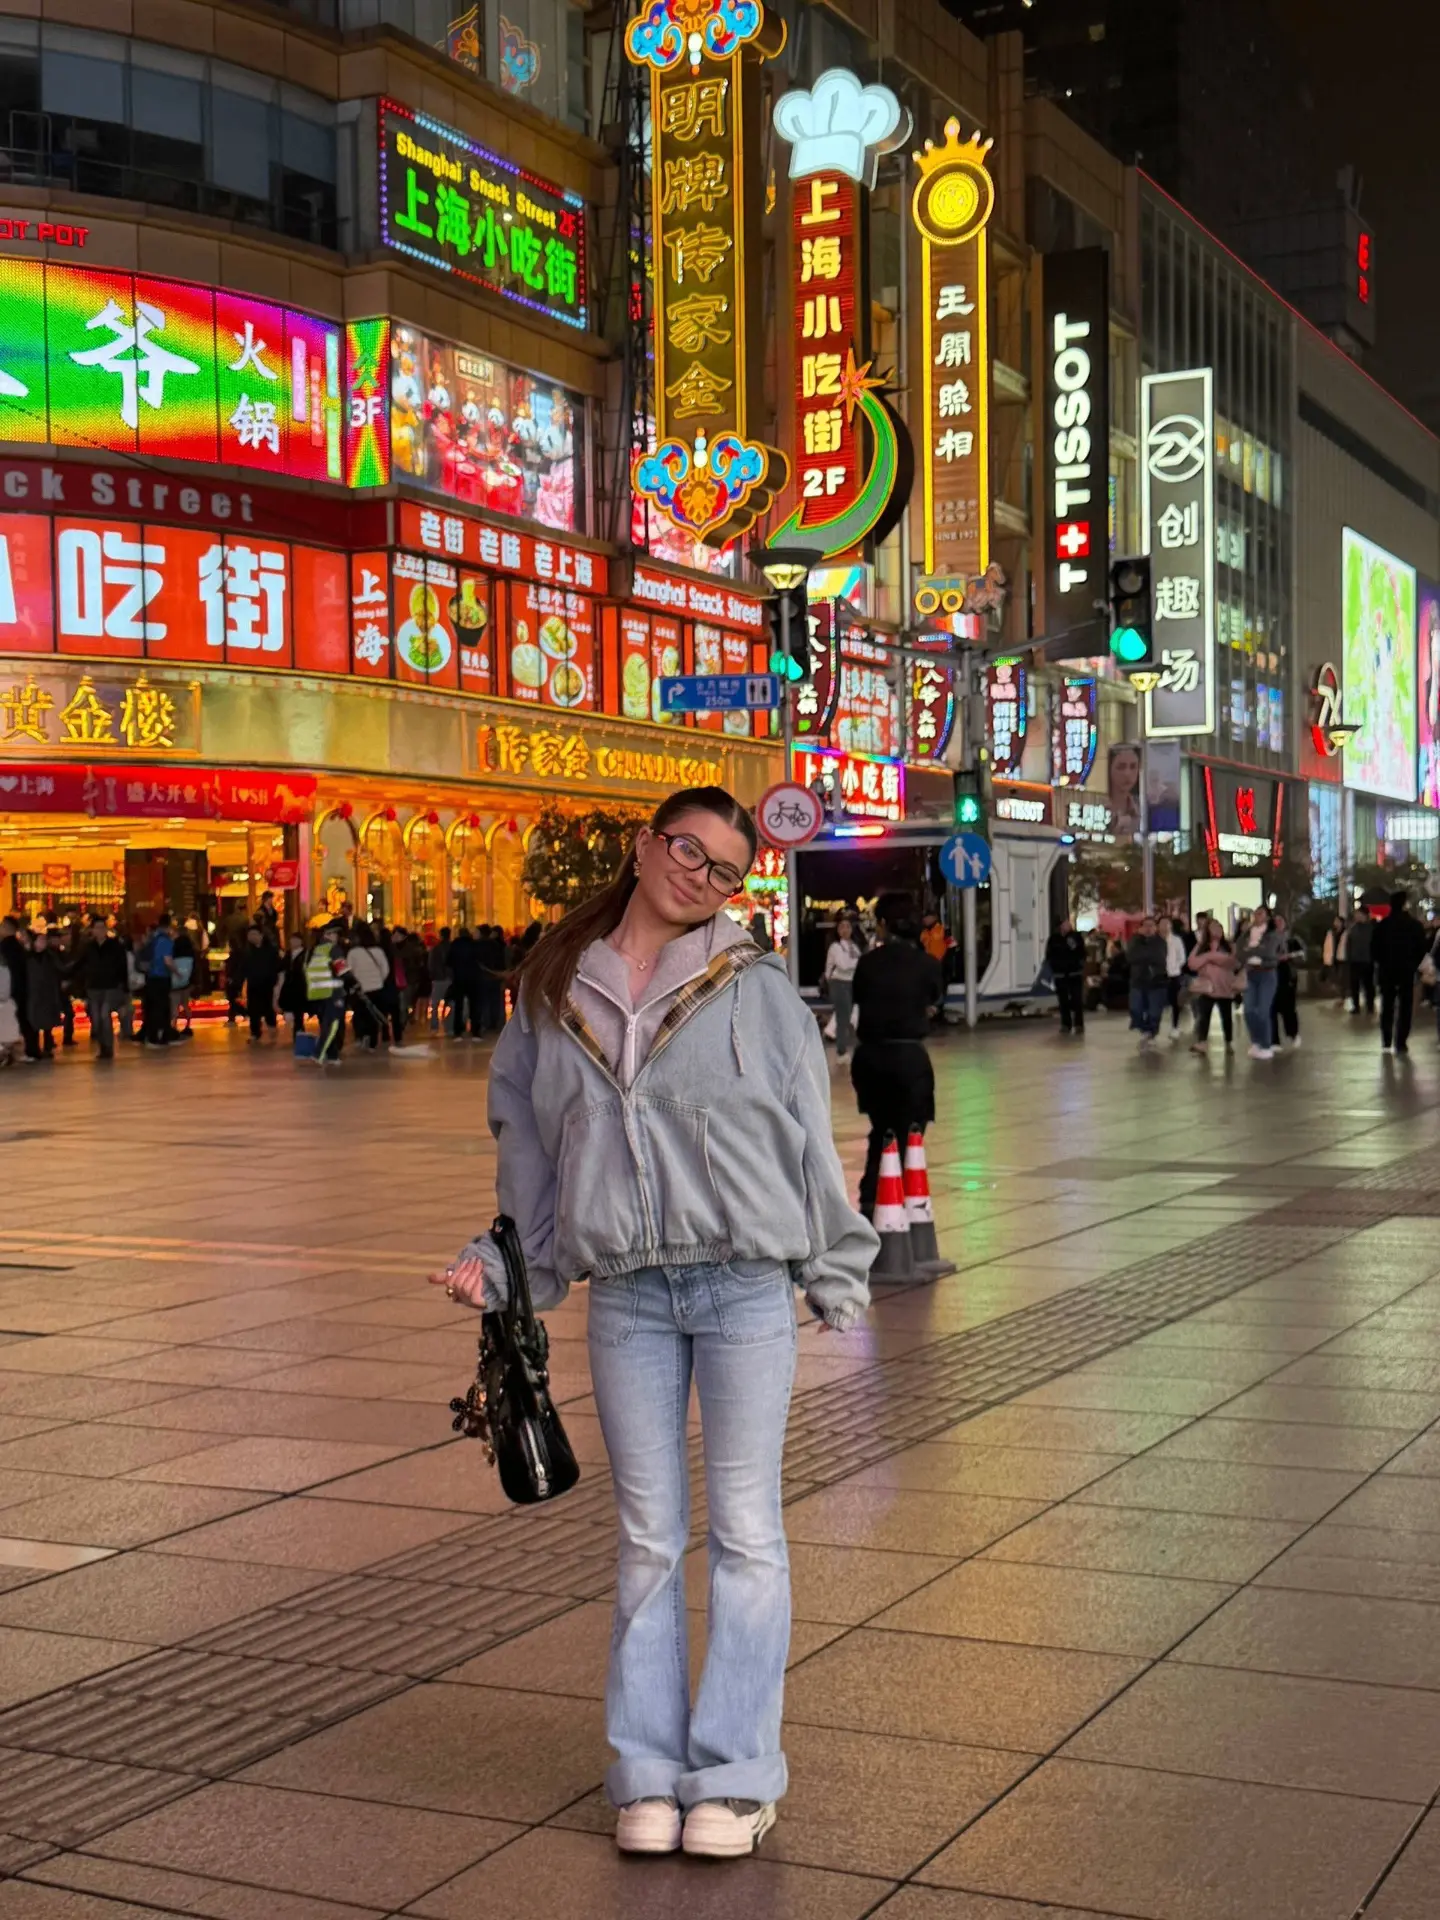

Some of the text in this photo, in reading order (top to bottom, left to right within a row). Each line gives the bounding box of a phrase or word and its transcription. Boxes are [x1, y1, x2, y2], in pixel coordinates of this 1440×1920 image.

[396, 131, 463, 184] Shanghai
[469, 168, 511, 207] Snack
[516, 191, 557, 230] Street
[38, 222, 89, 247] POT
[395, 168, 577, 304] 上海小吃街
[801, 179, 843, 455] 上海小吃街
[227, 321, 280, 454] 火锅
[350, 396, 382, 428] 3F
[1054, 312, 1091, 518] TISSOT
[91, 472, 254, 522] Street
[803, 465, 846, 498] 2F
[352, 568, 390, 666] 上海
[632, 571, 762, 627] Shanghai Snack Street
[1154, 500, 1200, 692] 创趣场
